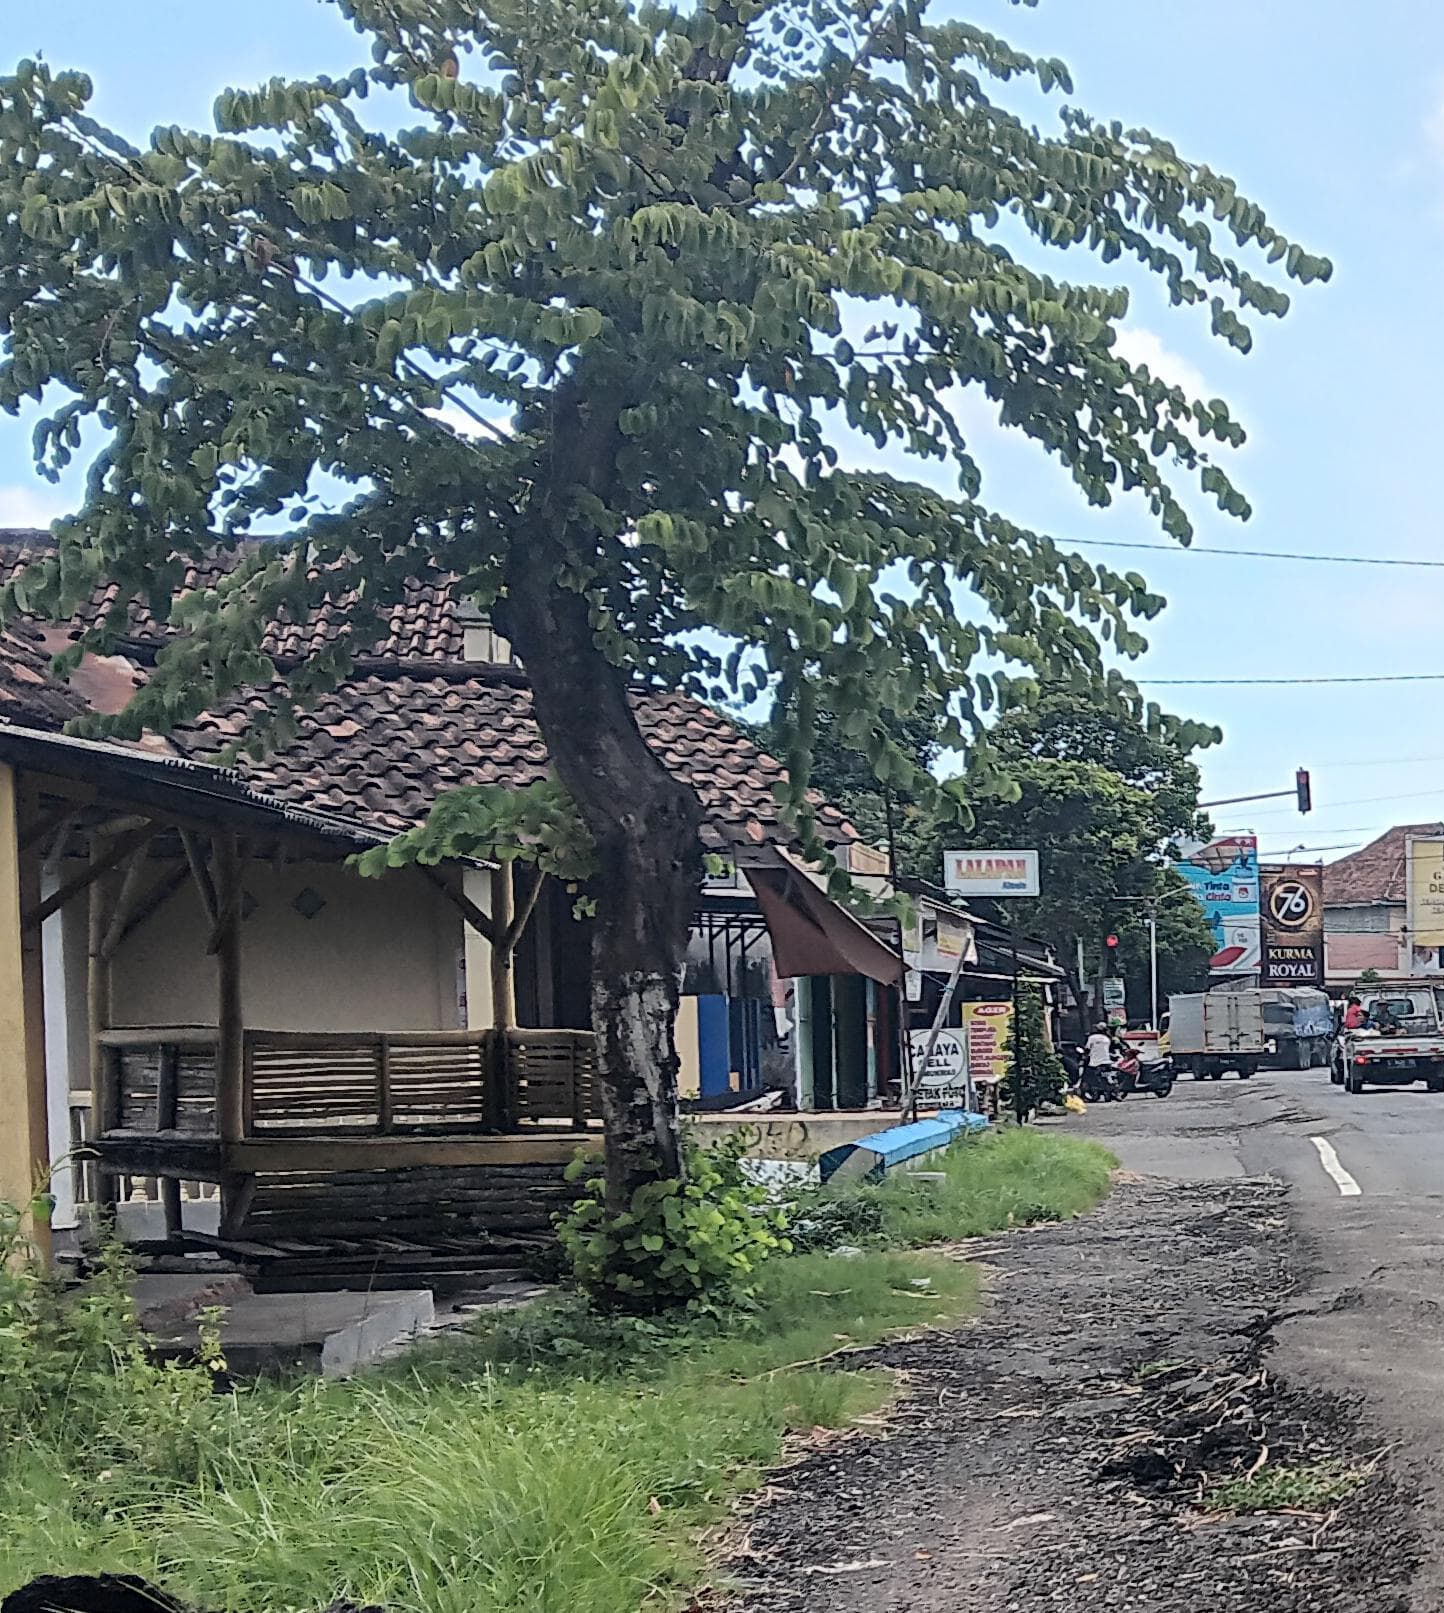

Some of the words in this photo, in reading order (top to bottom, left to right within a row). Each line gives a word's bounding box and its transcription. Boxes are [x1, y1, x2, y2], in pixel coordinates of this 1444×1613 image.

[1204, 881, 1230, 891] Tinta
[1429, 883, 1444, 893] DE
[1279, 887, 1306, 920] 76
[1268, 948, 1315, 960] KURMA
[1269, 963, 1316, 977] ROYAL
[910, 1043, 959, 1057] CAAYA
